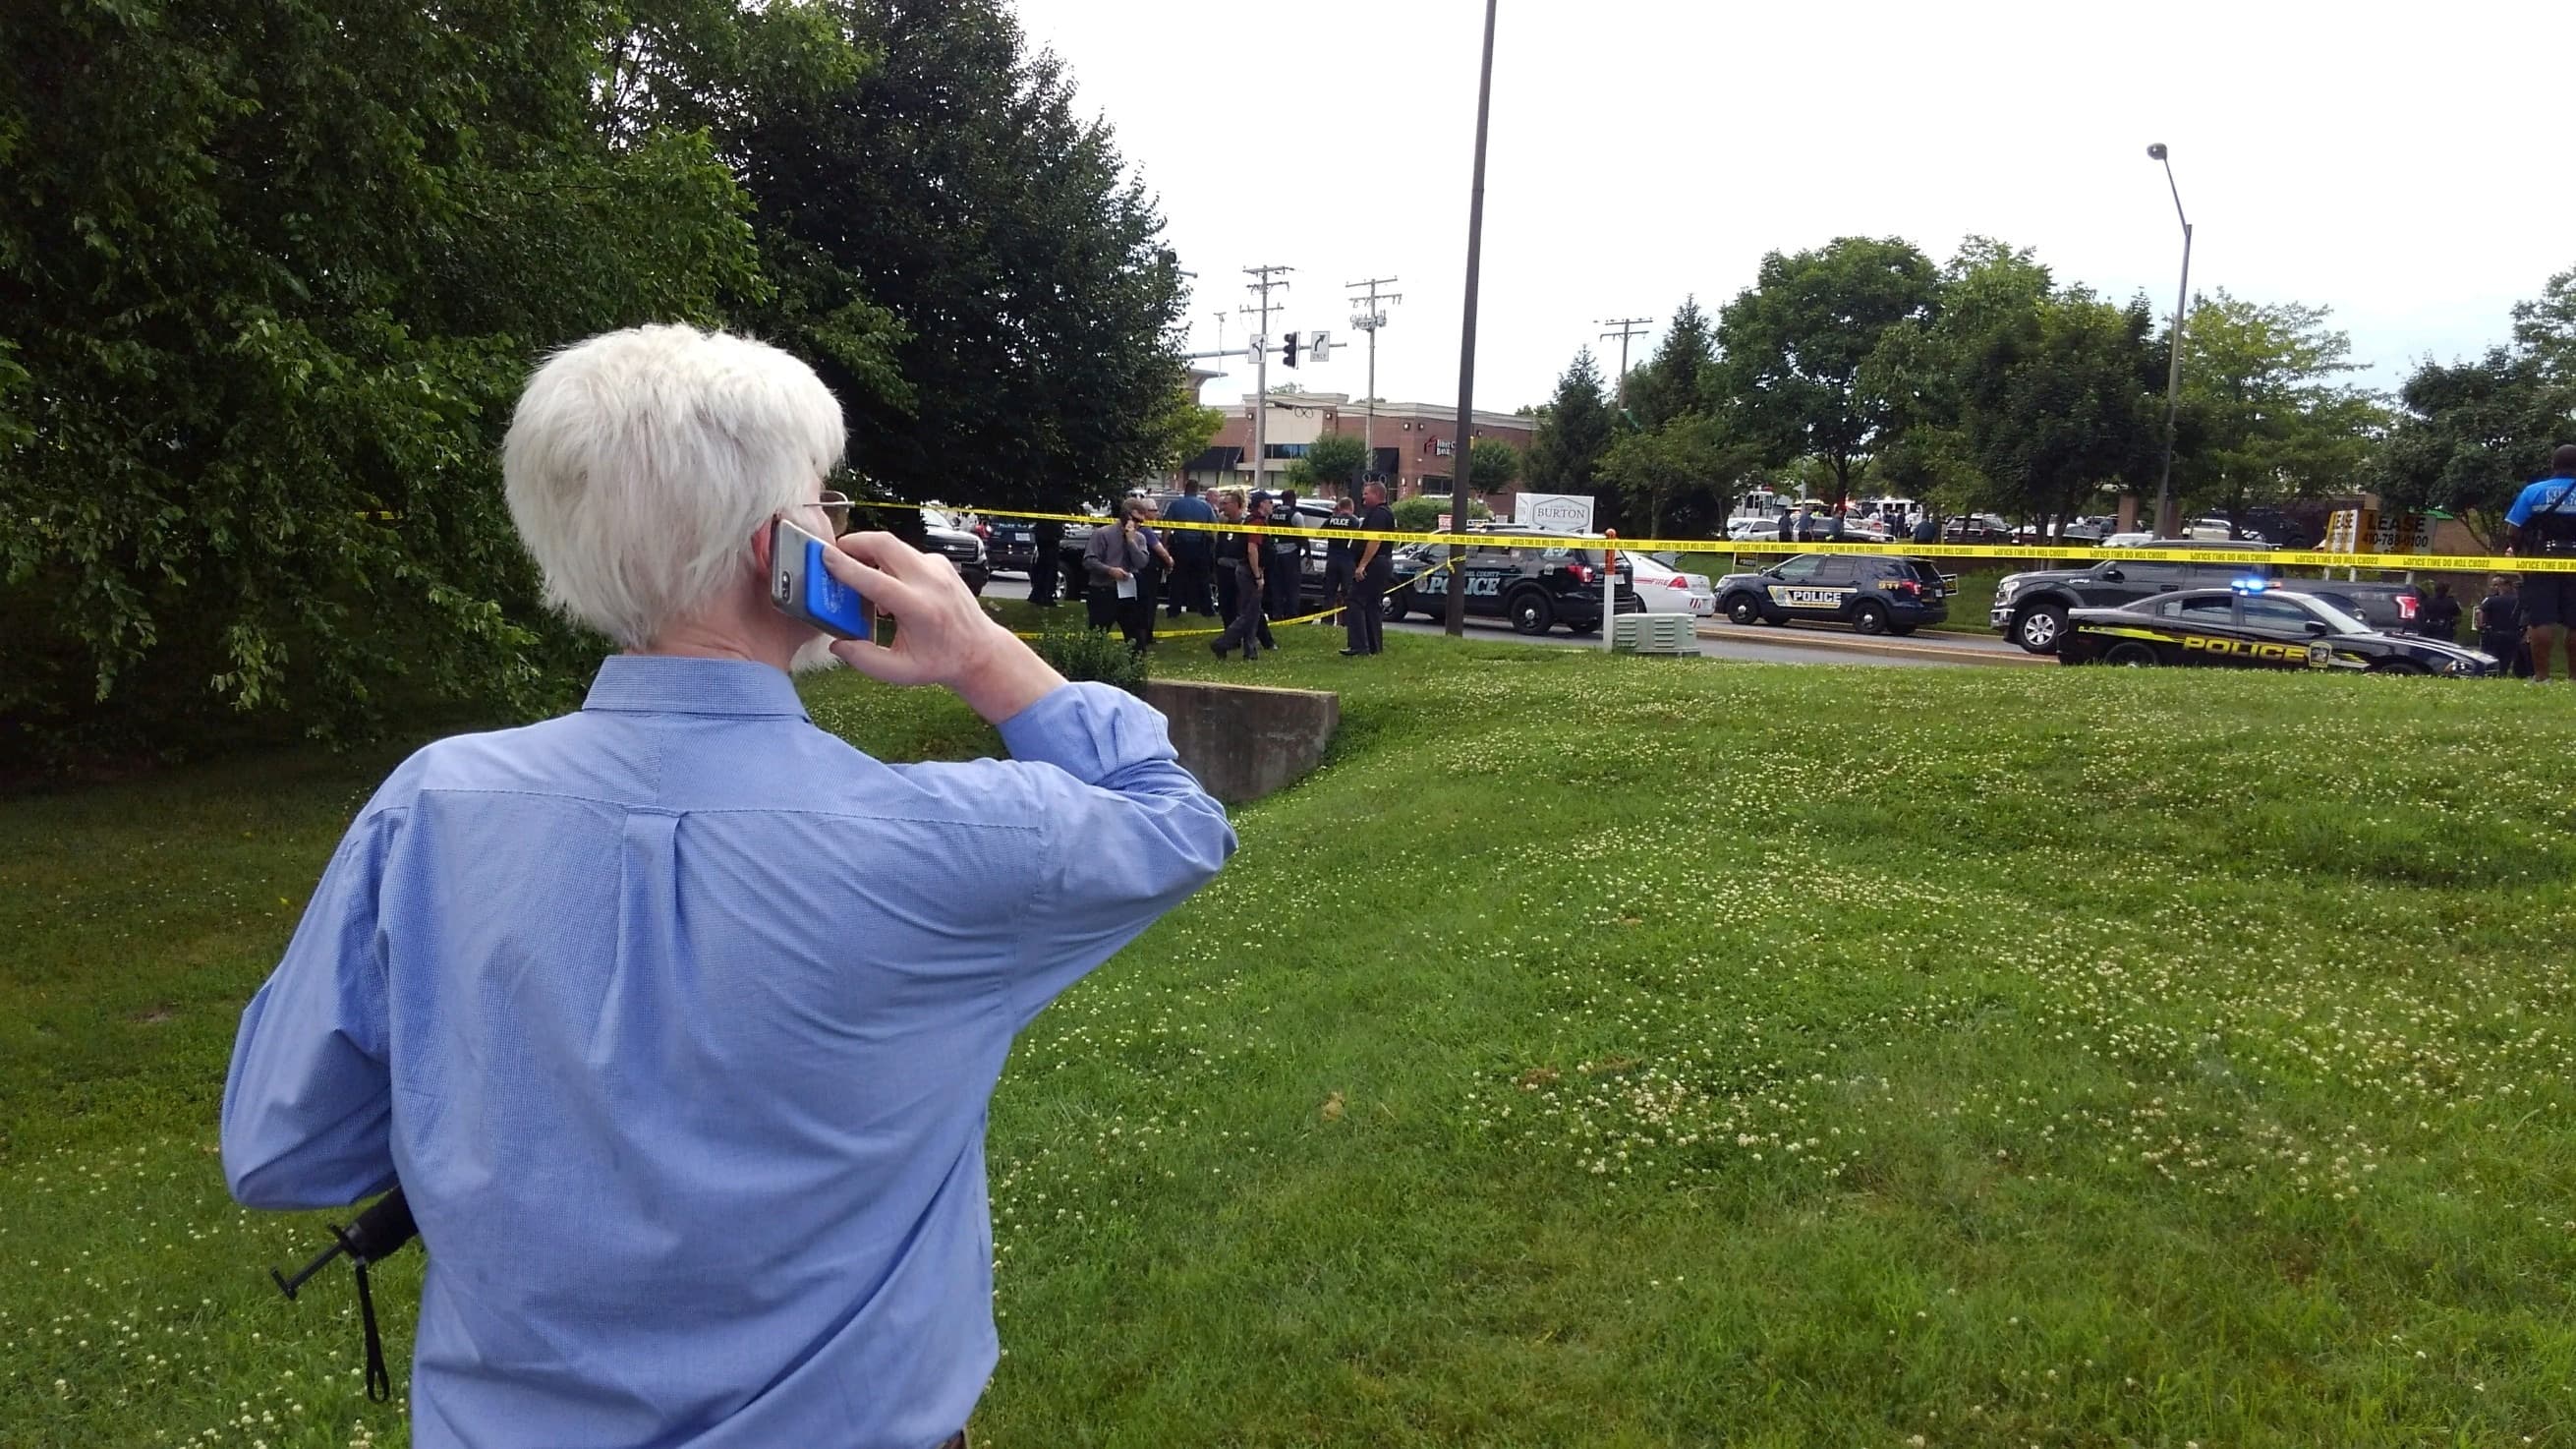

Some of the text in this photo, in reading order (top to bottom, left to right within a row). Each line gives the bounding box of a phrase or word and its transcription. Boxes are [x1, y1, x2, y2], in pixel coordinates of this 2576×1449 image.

[1537, 507, 1585, 519] BURTON
[1329, 517, 1349, 527] POLICE
[2367, 513, 2426, 533] LEASE
[1428, 576, 1501, 596] PICE
[1651, 577, 1669, 587] FIRE
[1793, 591, 1842, 603] POLICE
[2183, 636, 2307, 663] POLICE
